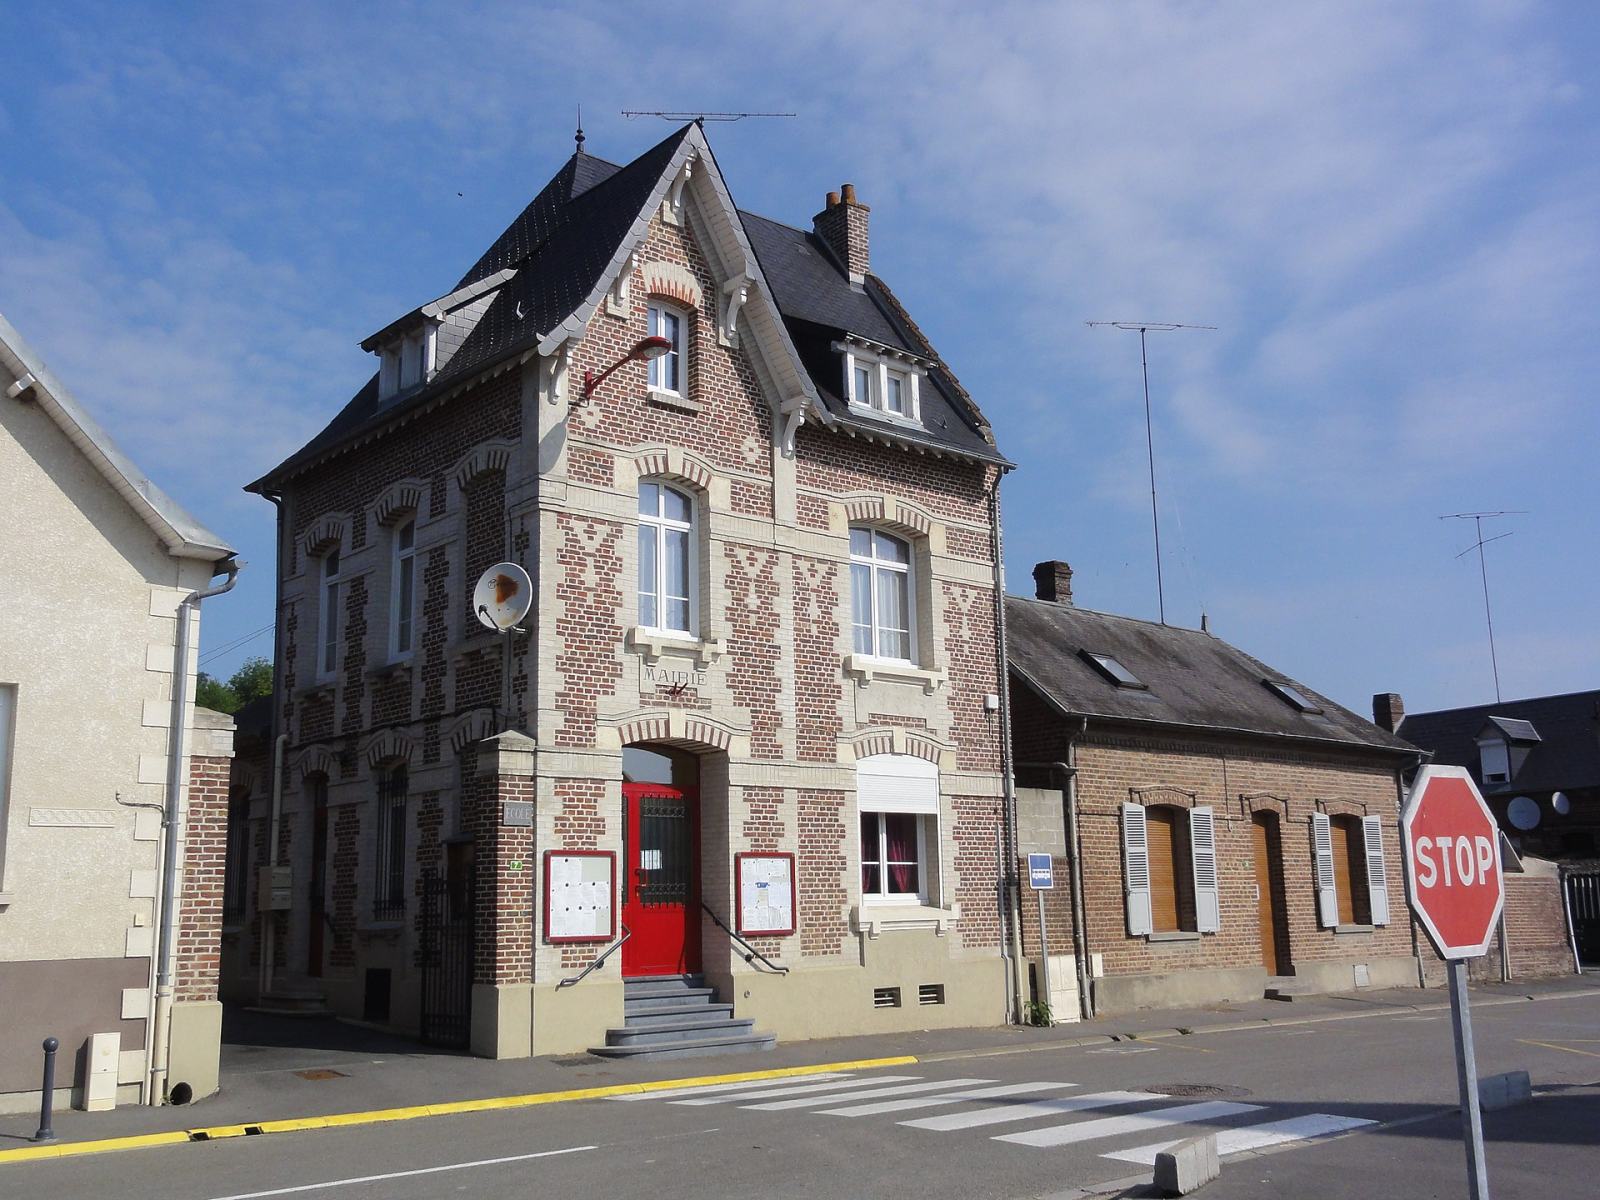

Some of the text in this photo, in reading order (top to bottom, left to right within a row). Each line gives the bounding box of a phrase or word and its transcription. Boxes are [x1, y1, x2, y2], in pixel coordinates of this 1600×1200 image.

[643, 667, 707, 686] MAIRIE
[505, 807, 530, 820] ECOLE
[1415, 835, 1493, 888] STOP
